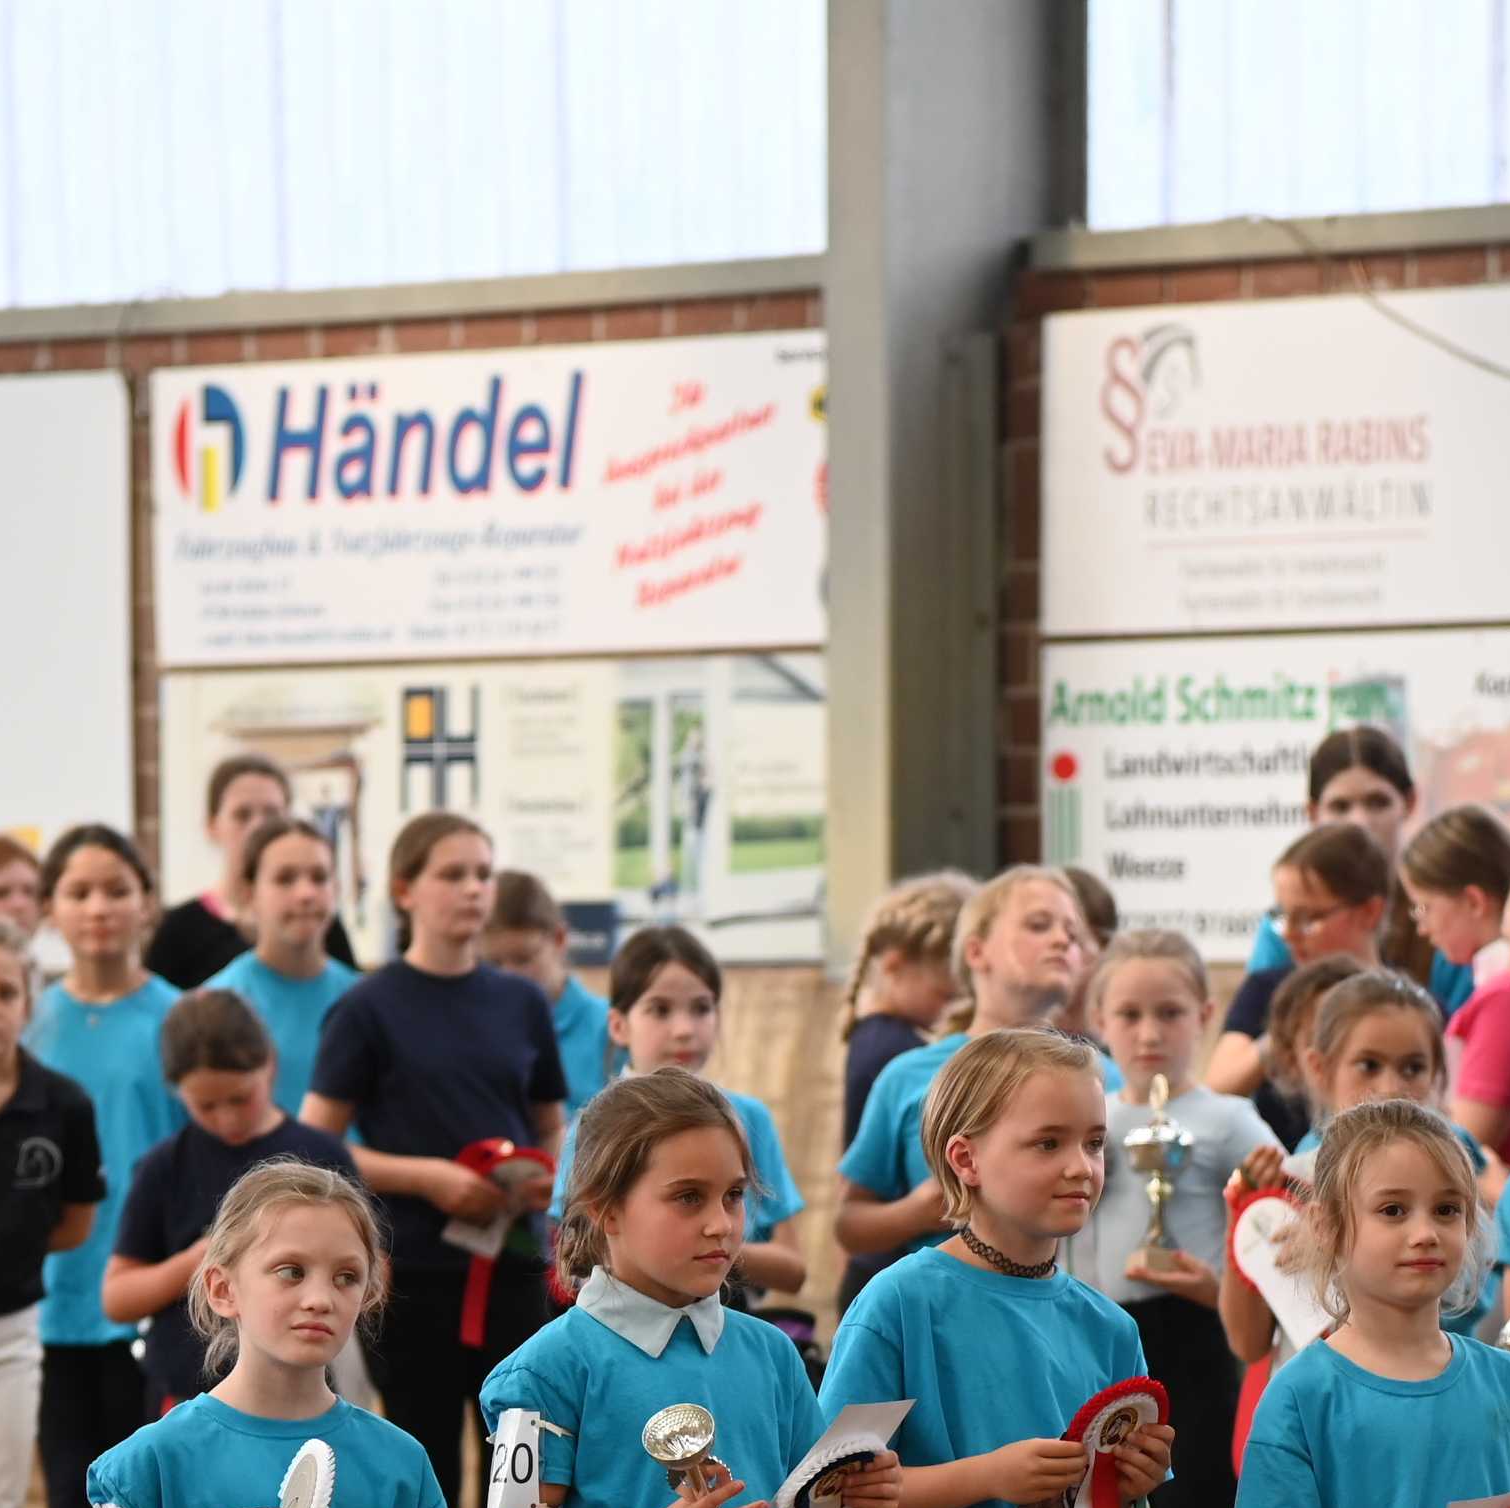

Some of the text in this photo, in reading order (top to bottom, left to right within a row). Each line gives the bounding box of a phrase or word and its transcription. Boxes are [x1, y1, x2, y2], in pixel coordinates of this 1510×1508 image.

[268, 370, 585, 502] Händel
[1048, 673, 1168, 726] Arnold
[1175, 669, 1319, 724] Schmitz
